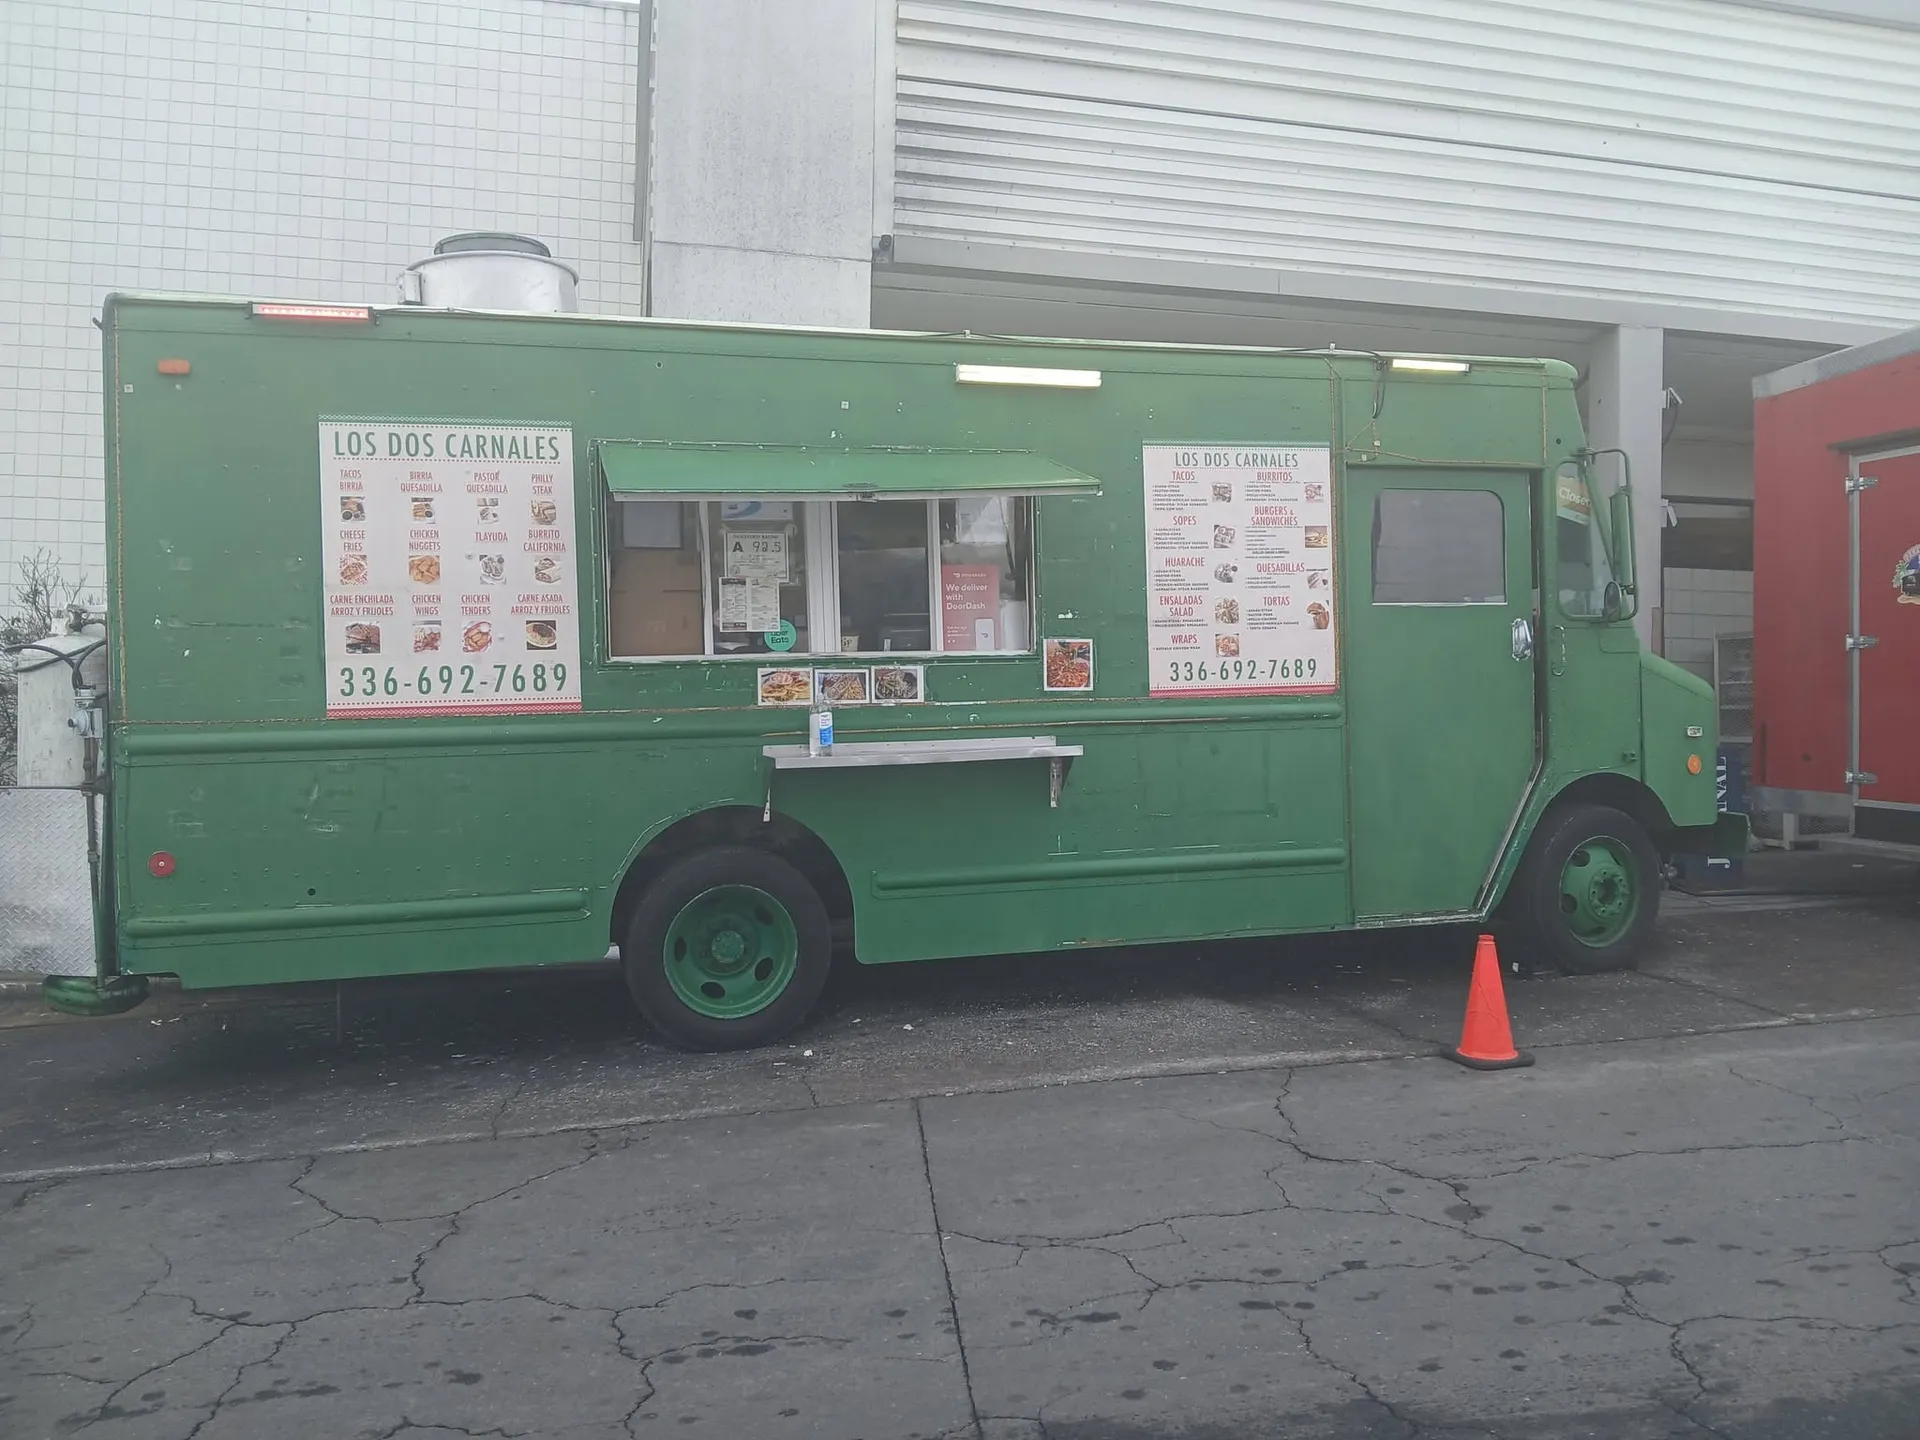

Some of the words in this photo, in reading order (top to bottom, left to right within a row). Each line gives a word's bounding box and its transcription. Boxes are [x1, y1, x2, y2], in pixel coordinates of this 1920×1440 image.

[334, 431, 377, 457] LOS
[388, 432, 434, 457] DOS
[445, 434, 560, 460] CARNALES
[1175, 452, 1198, 467] LOS
[1204, 453, 1230, 467] DOS
[1235, 453, 1298, 468] CARNALES
[340, 469, 362, 479] TACOS
[409, 471, 433, 481] BIRRIA
[473, 472, 499, 482] PASTOR
[531, 473, 553, 483] PHILLY
[1172, 471, 1195, 481] TACOS
[1257, 471, 1293, 482] BURRITOS
[339, 481, 363, 491] BIRRIA
[400, 483, 443, 493] QUESADILLA
[466, 483, 508, 494] QUESADILLA
[532, 485, 553, 495] STEAK
[1254, 506, 1288, 516] BURGERS
[1173, 516, 1197, 525] SOPES
[1251, 516, 1298, 526] SANDWICHES
[339, 530, 366, 539] CHEESE
[409, 530, 439, 539] CHICKEN
[475, 532, 508, 542] TLAYUDA
[528, 529, 560, 539] BURRITO
[343, 542, 363, 551] FRIES
[409, 541, 441, 551] NUGGETS
[523, 542, 566, 552] CALIFORNIA
[733, 541, 744, 552] A
[1165, 557, 1205, 567] HUARACHE
[1256, 563, 1305, 574] QUESADILLAS
[945, 583, 960, 591] We
[961, 583, 988, 591] deliver
[330, 595, 352, 604] CARNE
[354, 595, 394, 604] ENCHILADA
[412, 594, 441, 604] CHICKEN
[461, 594, 490, 603] CHICKEN
[517, 594, 540, 603] CARNE
[541, 594, 563, 602] ASADA
[945, 593, 964, 601] with
[1160, 595, 1203, 605] ENSALADAS
[1263, 596, 1290, 606] TORTAS
[331, 606, 354, 616] ARROZ
[355, 606, 361, 616] Y
[362, 606, 394, 616] FRIJOLES
[414, 606, 439, 616] WINGS
[461, 606, 491, 616] TENDERS
[510, 605, 534, 614] ARROZ
[535, 605, 541, 614] Y
[542, 604, 571, 614] FRIJOLES
[946, 602, 986, 610] DoorDash
[1170, 607, 1194, 617] SALAD
[1171, 634, 1197, 644] WRAPS
[1170, 658, 1317, 682] 336-692-7689
[340, 663, 567, 696] 336-692-7689
